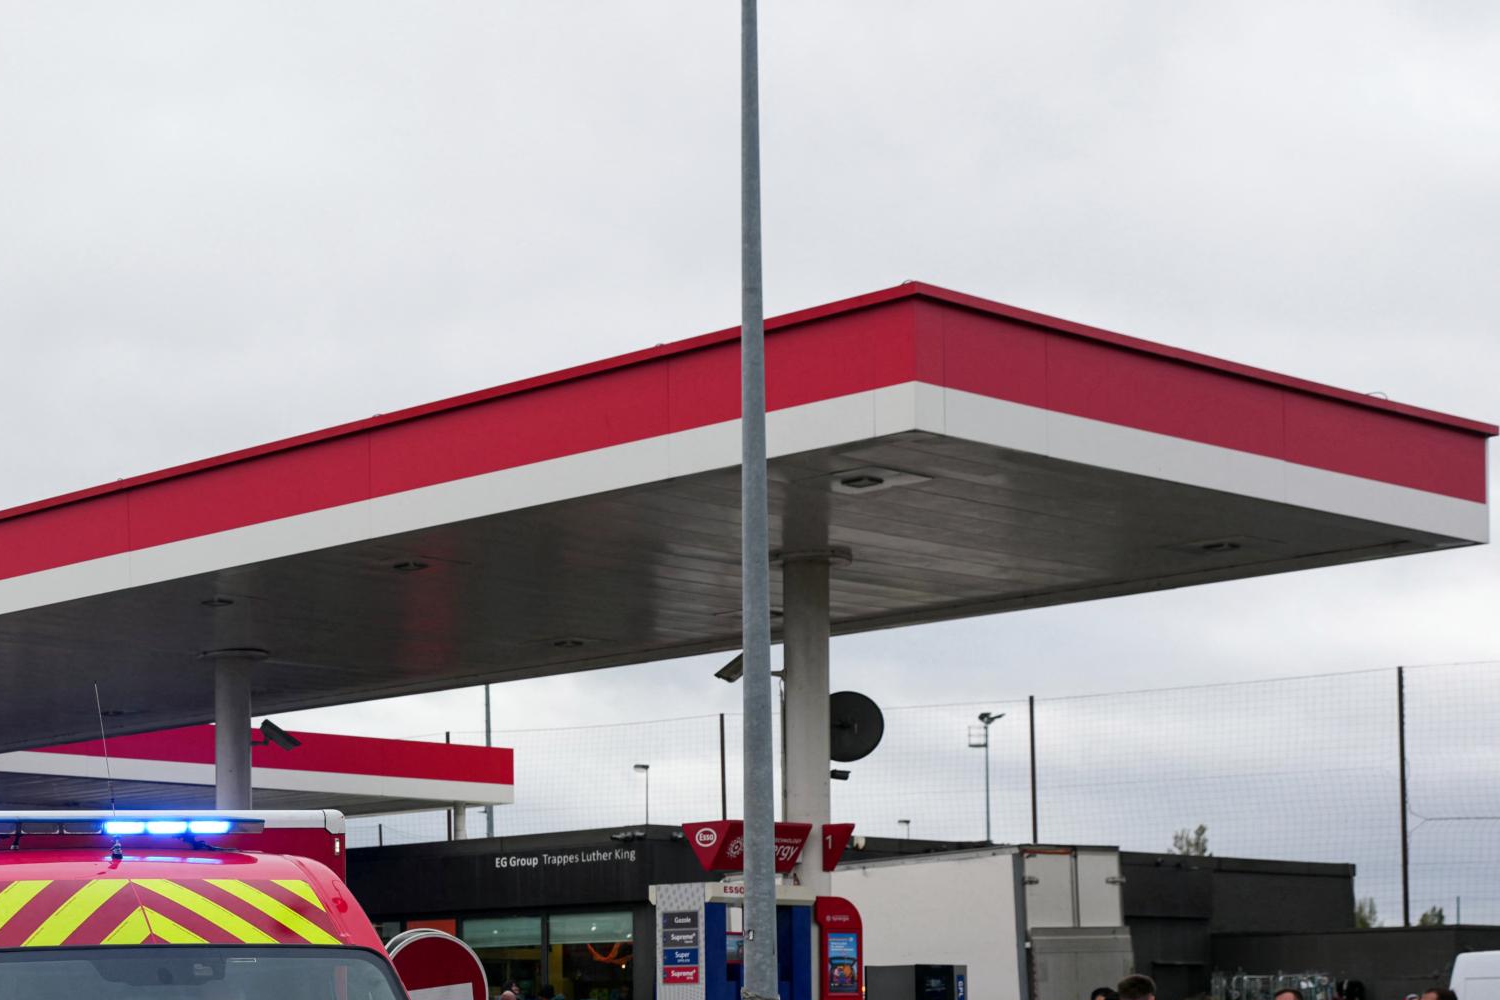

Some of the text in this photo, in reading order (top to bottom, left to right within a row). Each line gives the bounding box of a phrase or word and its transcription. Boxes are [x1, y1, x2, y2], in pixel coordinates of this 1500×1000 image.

[699, 832, 714, 842] Esso
[825, 835, 833, 849] 1
[495, 849, 636, 868] EG Group Trappes Luther King
[775, 844, 799, 861] ergy
[674, 916, 692, 924] Gazole
[675, 951, 690, 959] Super
[957, 981, 965, 997] GPL
